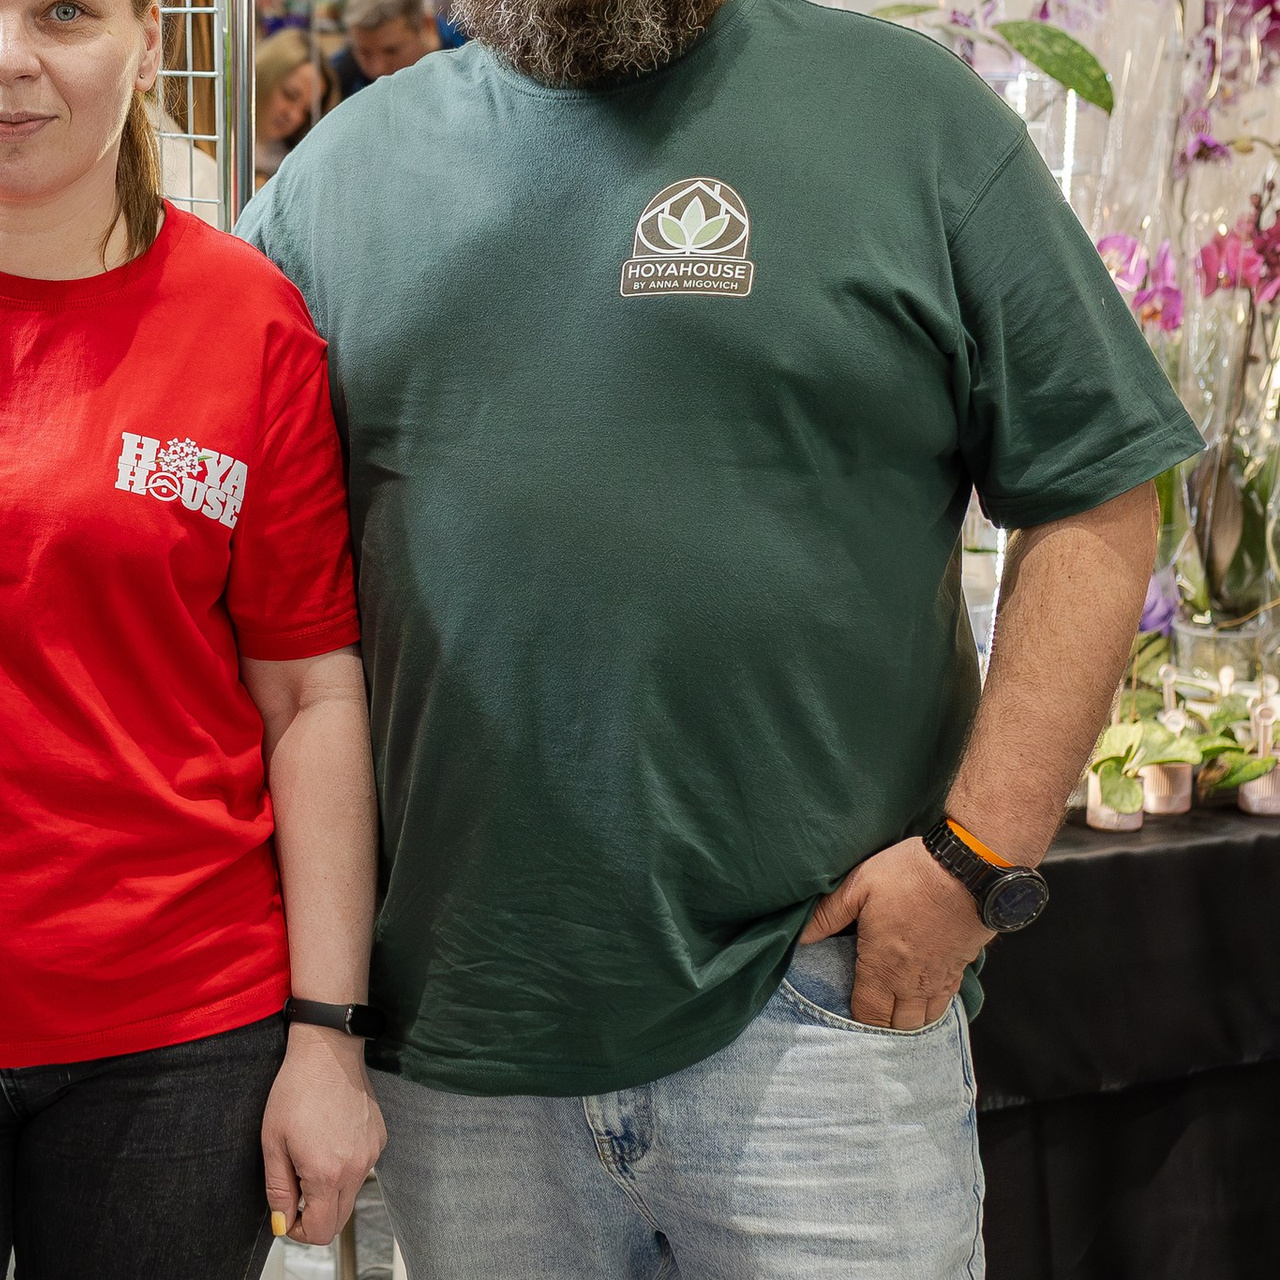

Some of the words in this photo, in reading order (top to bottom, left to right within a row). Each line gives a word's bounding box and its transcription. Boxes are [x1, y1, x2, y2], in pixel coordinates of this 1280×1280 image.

[628, 262, 747, 279] HOYAHOUSE
[633, 281, 646, 290] BY
[648, 279, 680, 289] ANNA
[683, 280, 739, 290] MIGOVICH
